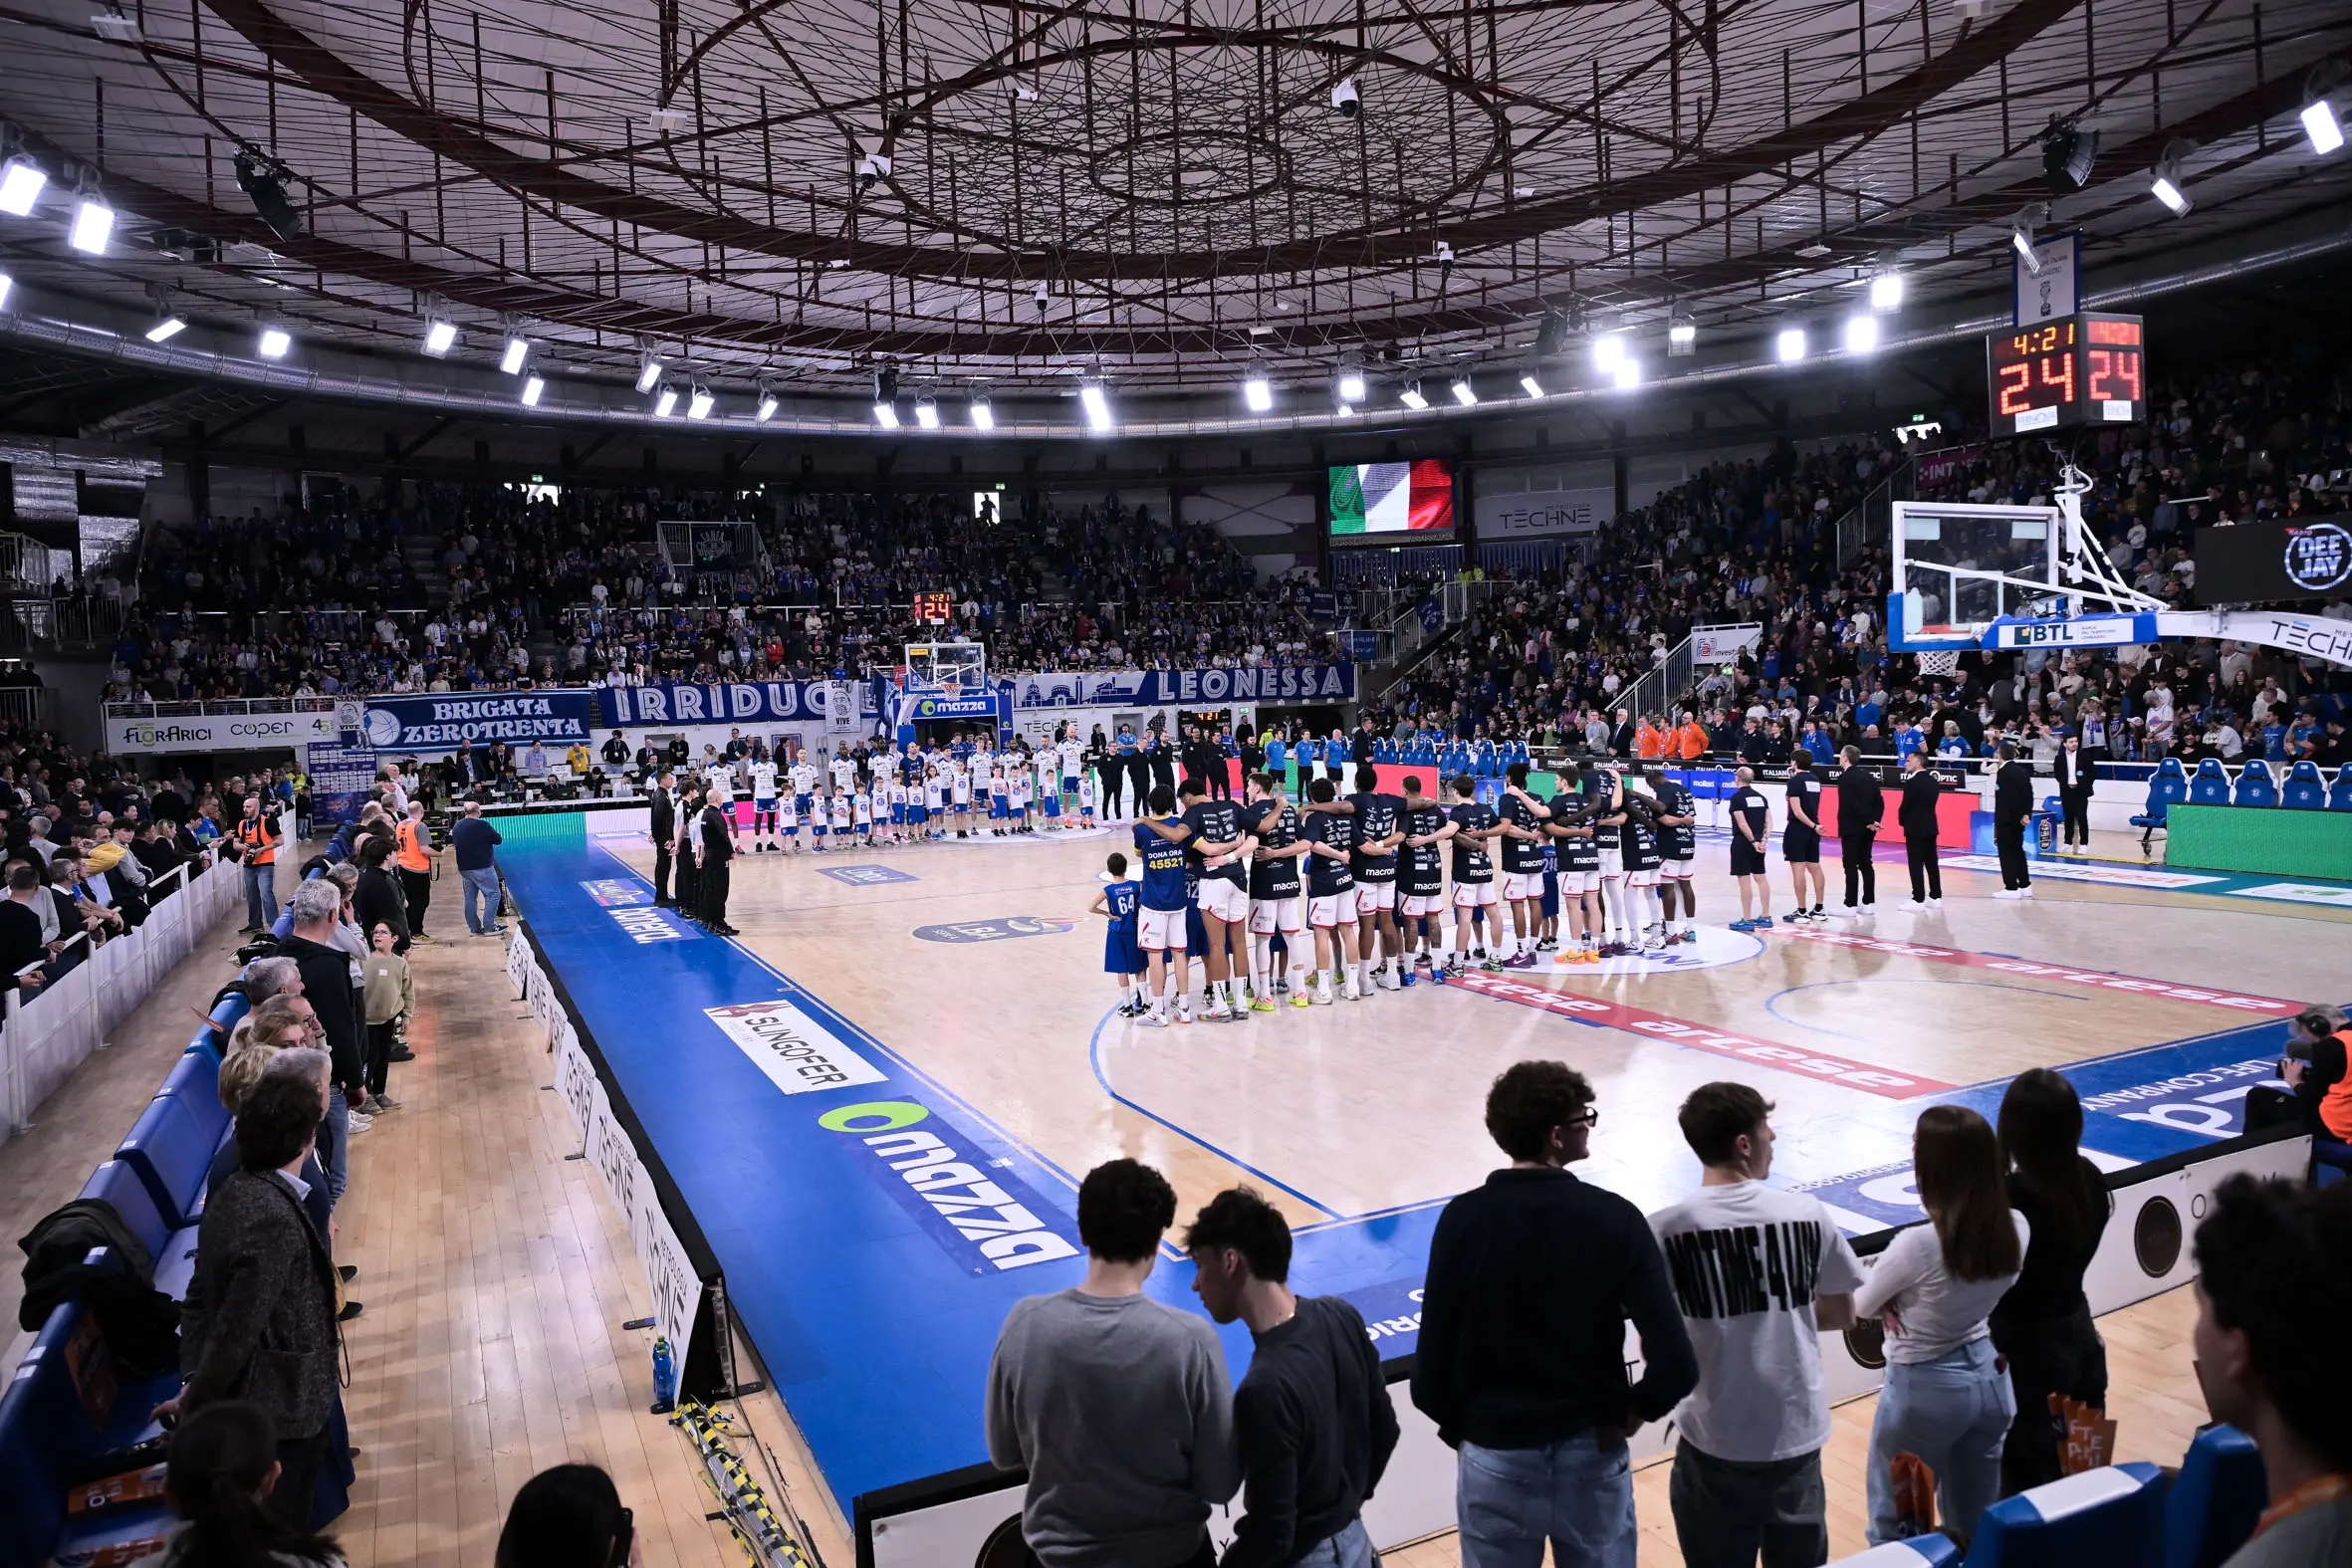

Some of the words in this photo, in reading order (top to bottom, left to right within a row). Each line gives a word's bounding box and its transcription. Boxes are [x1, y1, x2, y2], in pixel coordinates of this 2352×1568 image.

[2013, 323, 2074, 355] 4:21
[1999, 352, 2073, 415] 24
[2088, 349, 2139, 401] 24
[1499, 509, 1591, 530] TECHNE
[2298, 535, 2342, 558] DEE
[2298, 556, 2342, 578] JAY
[924, 602, 949, 619] 24
[2033, 624, 2073, 642] BTL
[2271, 620, 2352, 660] TECH
[1158, 666, 1344, 701] LEONESSA
[432, 698, 554, 722] BRIGATA
[613, 681, 826, 723] IRRIDUC
[937, 701, 986, 712] mazza
[402, 718, 585, 745] ZEROTRENTA
[835, 717, 850, 726] VIVE
[1762, 769, 1788, 778] ITALIAN
[1929, 770, 1959, 783] OPTIC
[1149, 857, 1184, 870] 45521
[1273, 881, 1299, 891] macro
[1336, 874, 1352, 886] mac
[1117, 894, 1134, 915] 64
[948, 923, 1009, 940] LBA
[1988, 961, 2288, 1010] arcese
[744, 1016, 848, 1086] SLINGOFER
[1632, 1020, 1916, 1088] arcese
[2223, 1059, 2277, 1078] LIFE
[2080, 1073, 2224, 1112] COMPANY
[597, 1114, 634, 1222] TECHNE
[1843, 1160, 1912, 1182] CREDITO
[862, 1131, 1080, 1270] mazza
[659, 1233, 688, 1298] METROLOGIA
